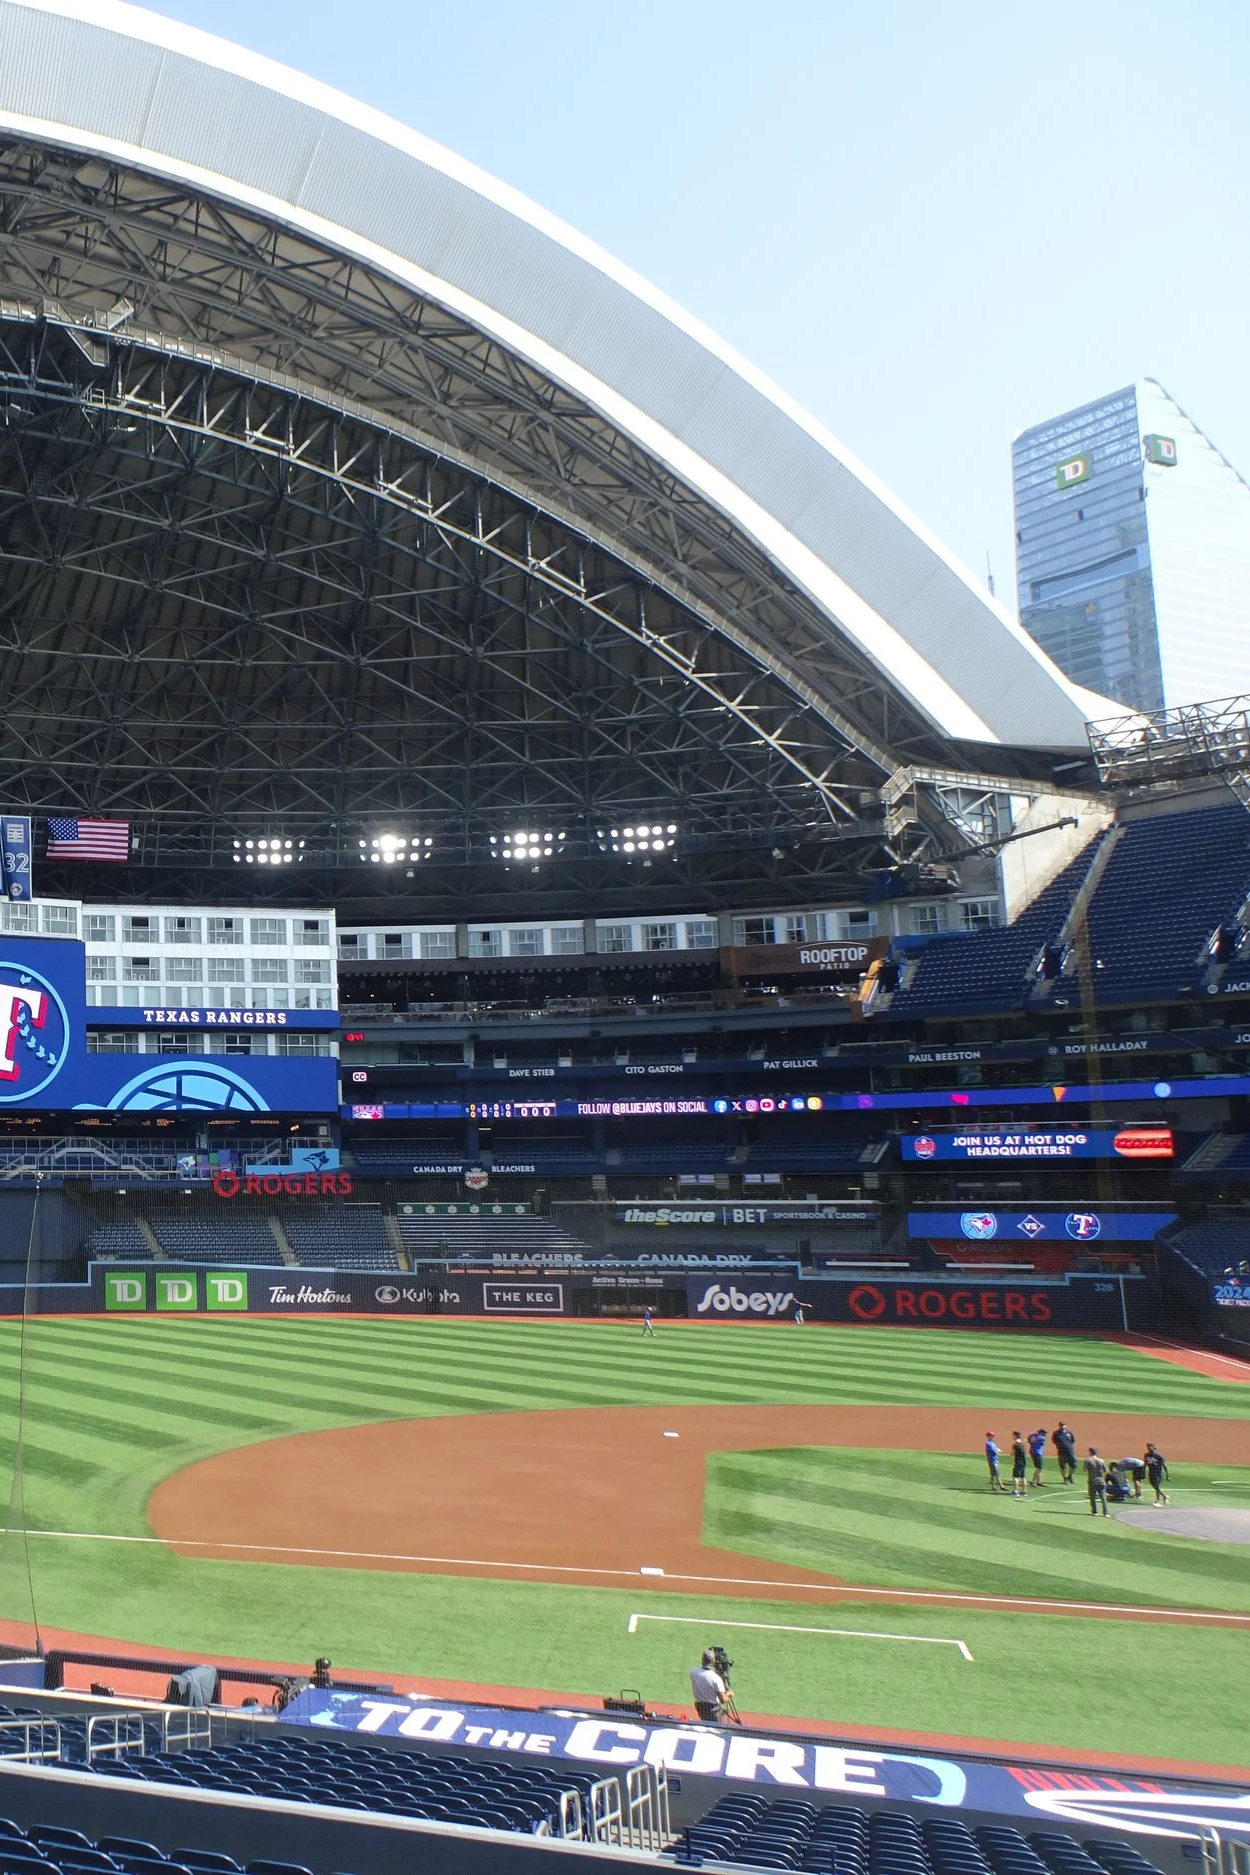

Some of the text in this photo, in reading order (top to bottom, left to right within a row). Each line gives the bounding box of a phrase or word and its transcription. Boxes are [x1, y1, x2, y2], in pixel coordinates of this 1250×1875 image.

[1157, 438, 1175, 459] TD
[1059, 459, 1086, 482] TD
[4, 852, 29, 873] 32
[800, 947, 868, 964] ROOFTOP
[820, 962, 850, 970] PATIO
[143, 1009, 287, 1025] TEXAS RANGERS
[1065, 1044, 1088, 1054] ROY
[1090, 1040, 1148, 1053] HALLADAY
[908, 1050, 981, 1062] PAUL BEESTON
[625, 1064, 684, 1074] CITO GASTON
[763, 1059, 818, 1070] PAT GILLICK
[354, 1073, 366, 1081] CC
[509, 1068, 555, 1077] DAVE STIEB
[577, 1101, 708, 1116] FOLLOW @BLUEJAYS ON SOCIAL
[952, 1134, 1087, 1147] JOIN US AT HOT DOG
[967, 1145, 1071, 1156] HEADQUARTERS!
[492, 1165, 535, 1173] BLEACHERS
[245, 1172, 352, 1196] ROGERS
[624, 1208, 716, 1223] theScore
[732, 1208, 768, 1223] BET
[773, 1212, 826, 1220] SPORTSBOOK
[834, 1212, 866, 1220] CASINO
[1023, 1222, 1038, 1230] VS
[1073, 1214, 1096, 1237] T
[109, 1279, 142, 1303] TD
[160, 1279, 193, 1303] TD
[210, 1279, 243, 1303] TD
[268, 1285, 352, 1304] Tim Hortons
[492, 1292, 554, 1303] THE KEG
[697, 1284, 794, 1316] Sobeys
[895, 1288, 1051, 1321] ROGERS
[356, 1701, 466, 1741] TO
[464, 1725, 557, 1754] THE
[563, 1719, 887, 1797] CORE
